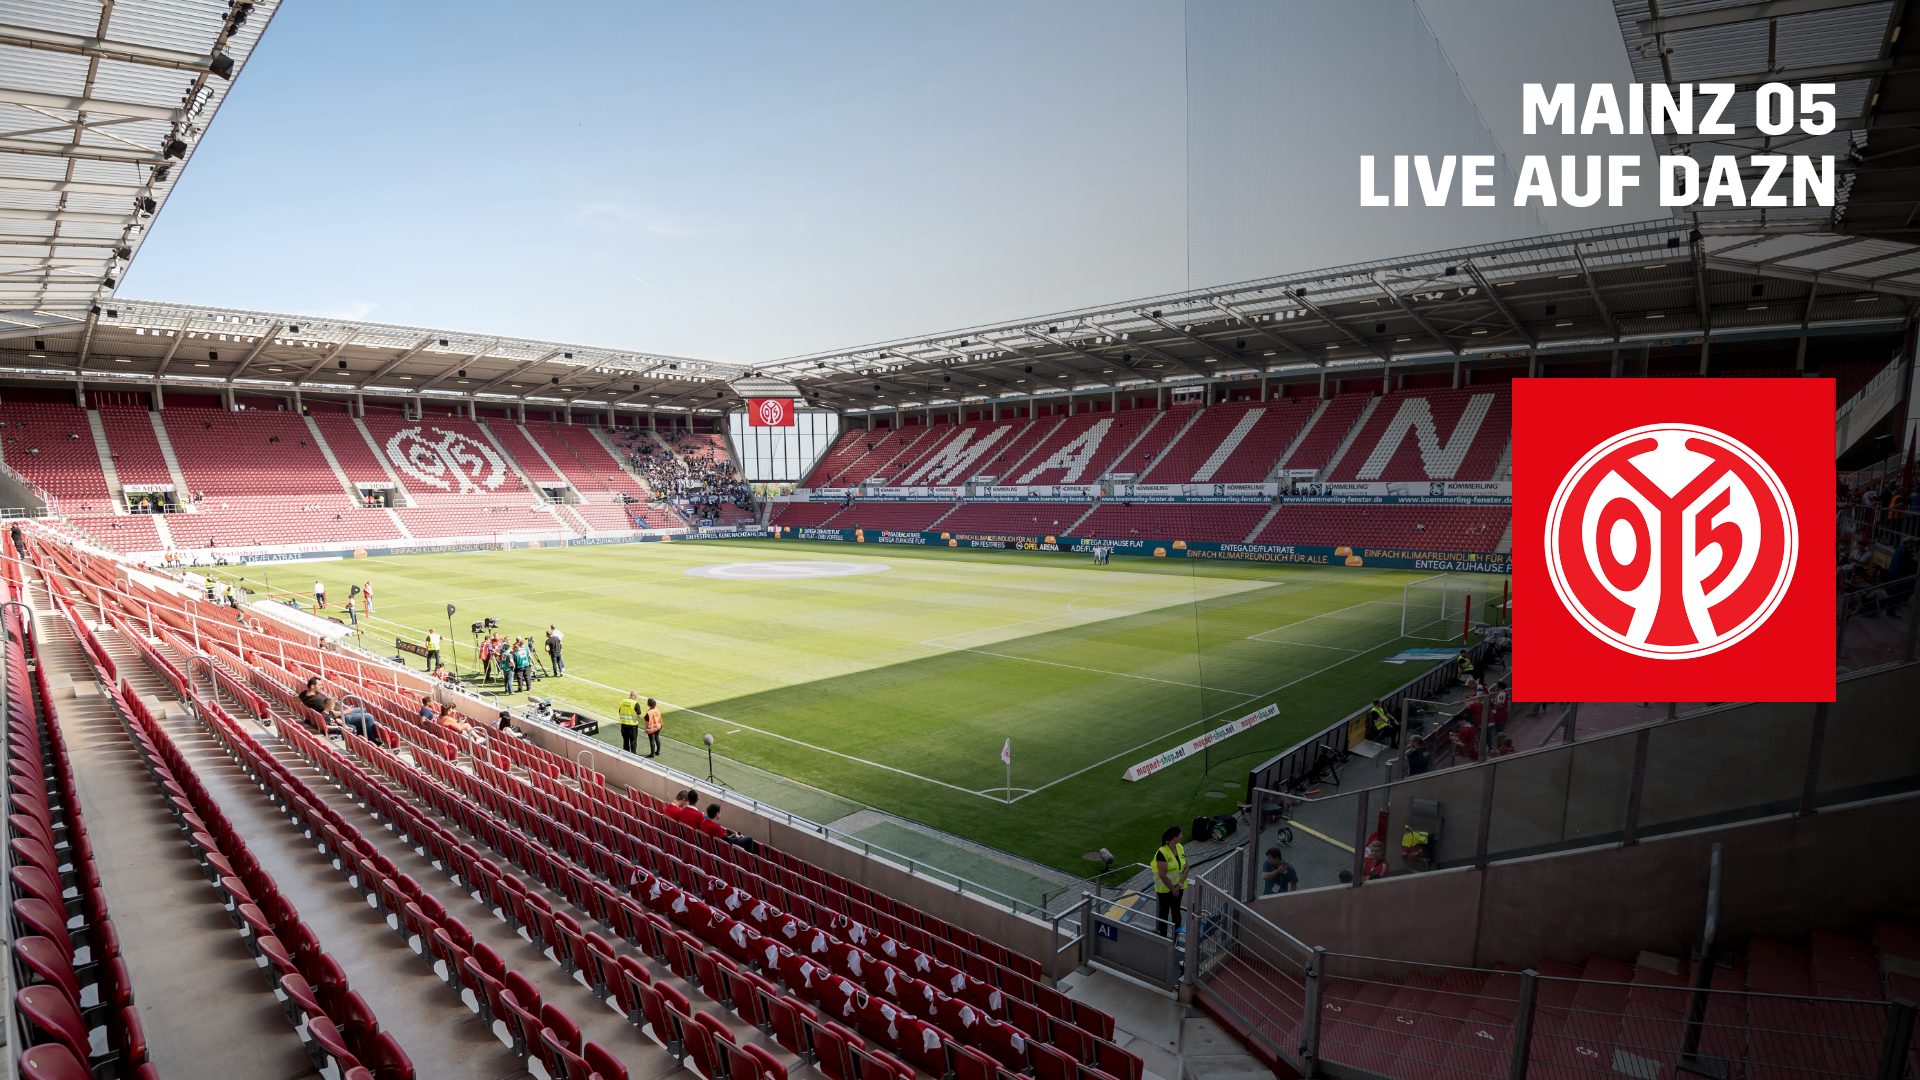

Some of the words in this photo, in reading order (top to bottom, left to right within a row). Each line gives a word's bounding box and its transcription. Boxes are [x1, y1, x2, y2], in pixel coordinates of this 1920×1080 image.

[1448, 482, 1498, 490] KÖMMERLING
[1024, 543, 1038, 551] OPEL
[1039, 544, 1059, 552] ARENA
[1102, 539, 1129, 547] ZUHAUSE
[390, 547, 421, 555] EINFACH
[1221, 544, 1295, 553] ENTEGA.DE/FLATRATE
[1187, 550, 1217, 558] EINFACH
[1218, 551, 1288, 562] KLIMAFREUNDLICH
[1290, 553, 1305, 563] FÜR
[1364, 549, 1400, 558] EINFACH
[1401, 551, 1482, 562] KLIMAFREUNDLIH
[1485, 553, 1503, 563] FÜR
[1415, 559, 1452, 570] ENTEGA
[1456, 561, 1506, 573] ZUHAUSE
[1136, 747, 1185, 776] magnet-shop.net
